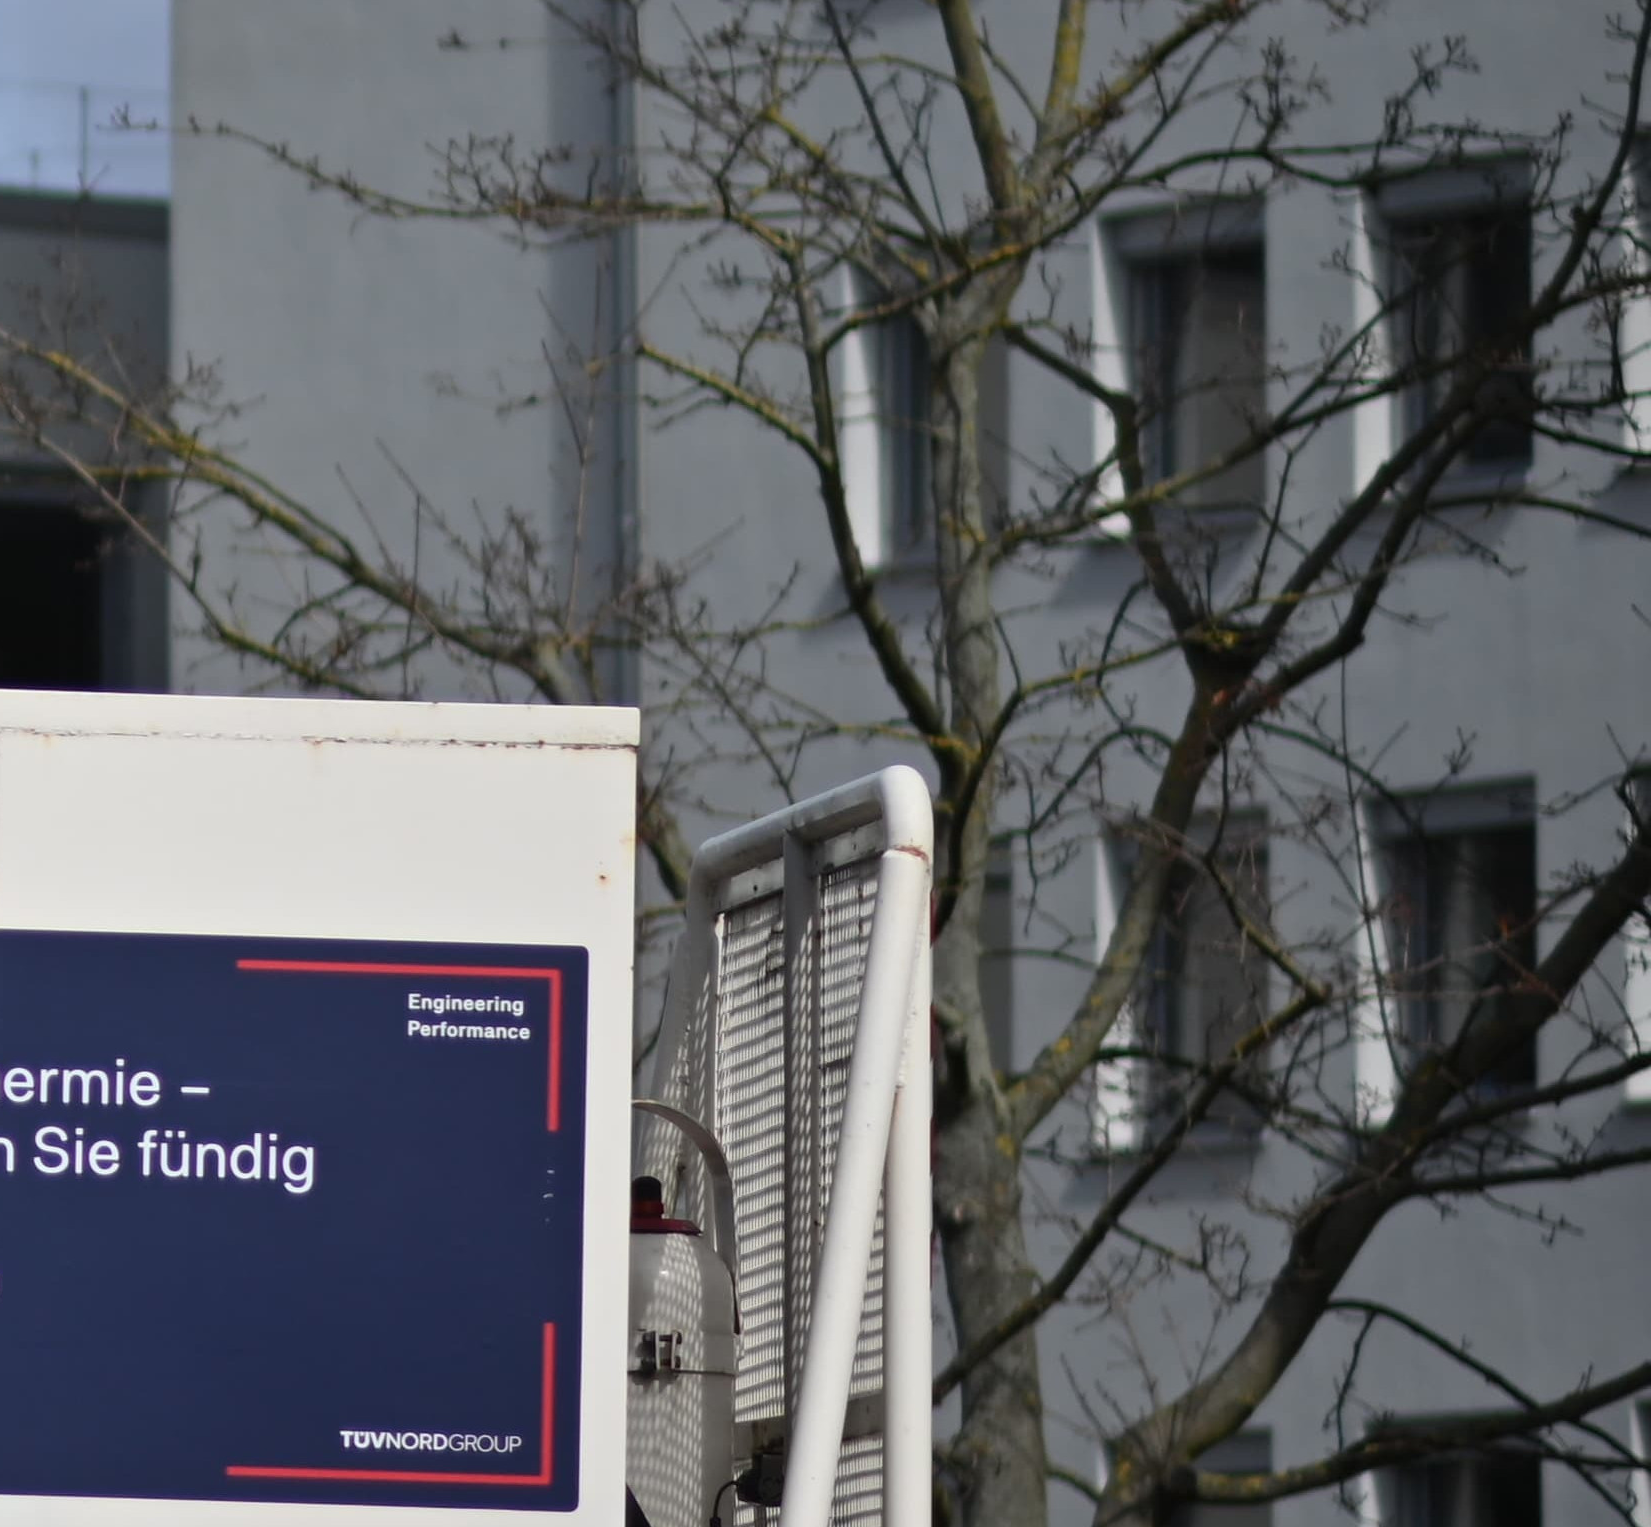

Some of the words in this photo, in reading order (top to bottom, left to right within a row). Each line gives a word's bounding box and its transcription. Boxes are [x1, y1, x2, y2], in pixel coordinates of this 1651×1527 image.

[408, 993, 526, 1018] Engineering
[407, 1018, 531, 1041] Performance
[32, 1125, 121, 1177] Sie
[136, 1128, 315, 1195] fündig
